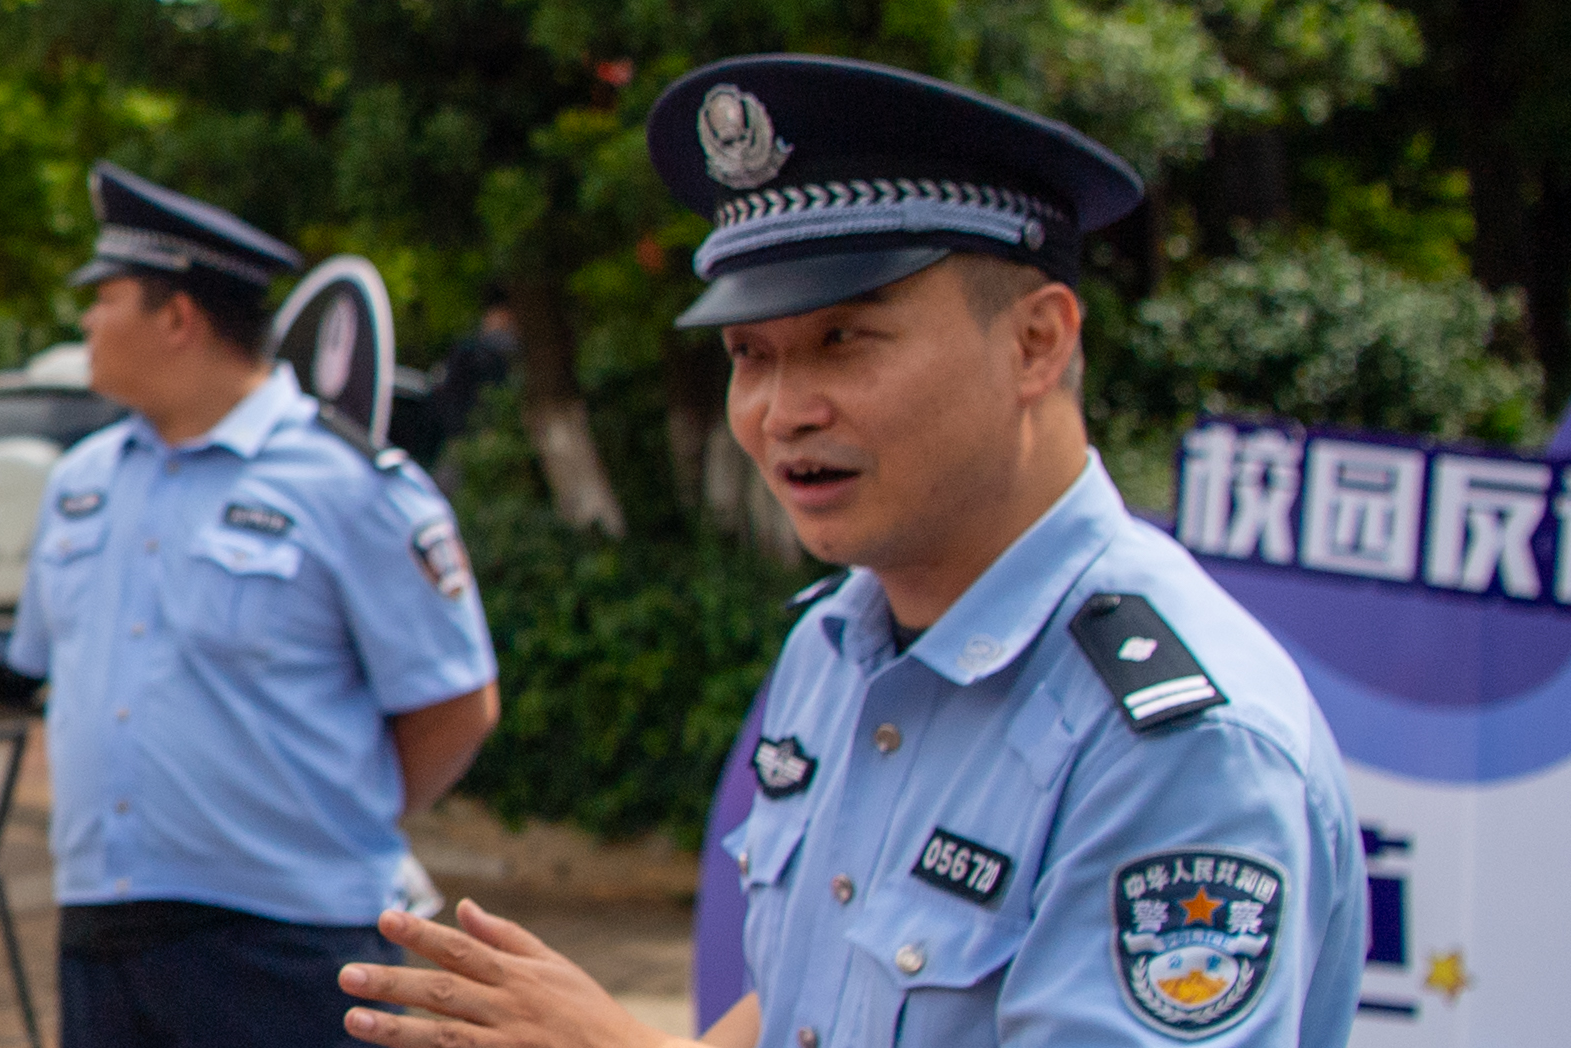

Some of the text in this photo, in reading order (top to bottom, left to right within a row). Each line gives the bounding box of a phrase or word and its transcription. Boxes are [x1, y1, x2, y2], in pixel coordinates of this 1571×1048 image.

[1176, 422, 1571, 604] 校园反
[1124, 857, 1278, 904] 中华人民共和国
